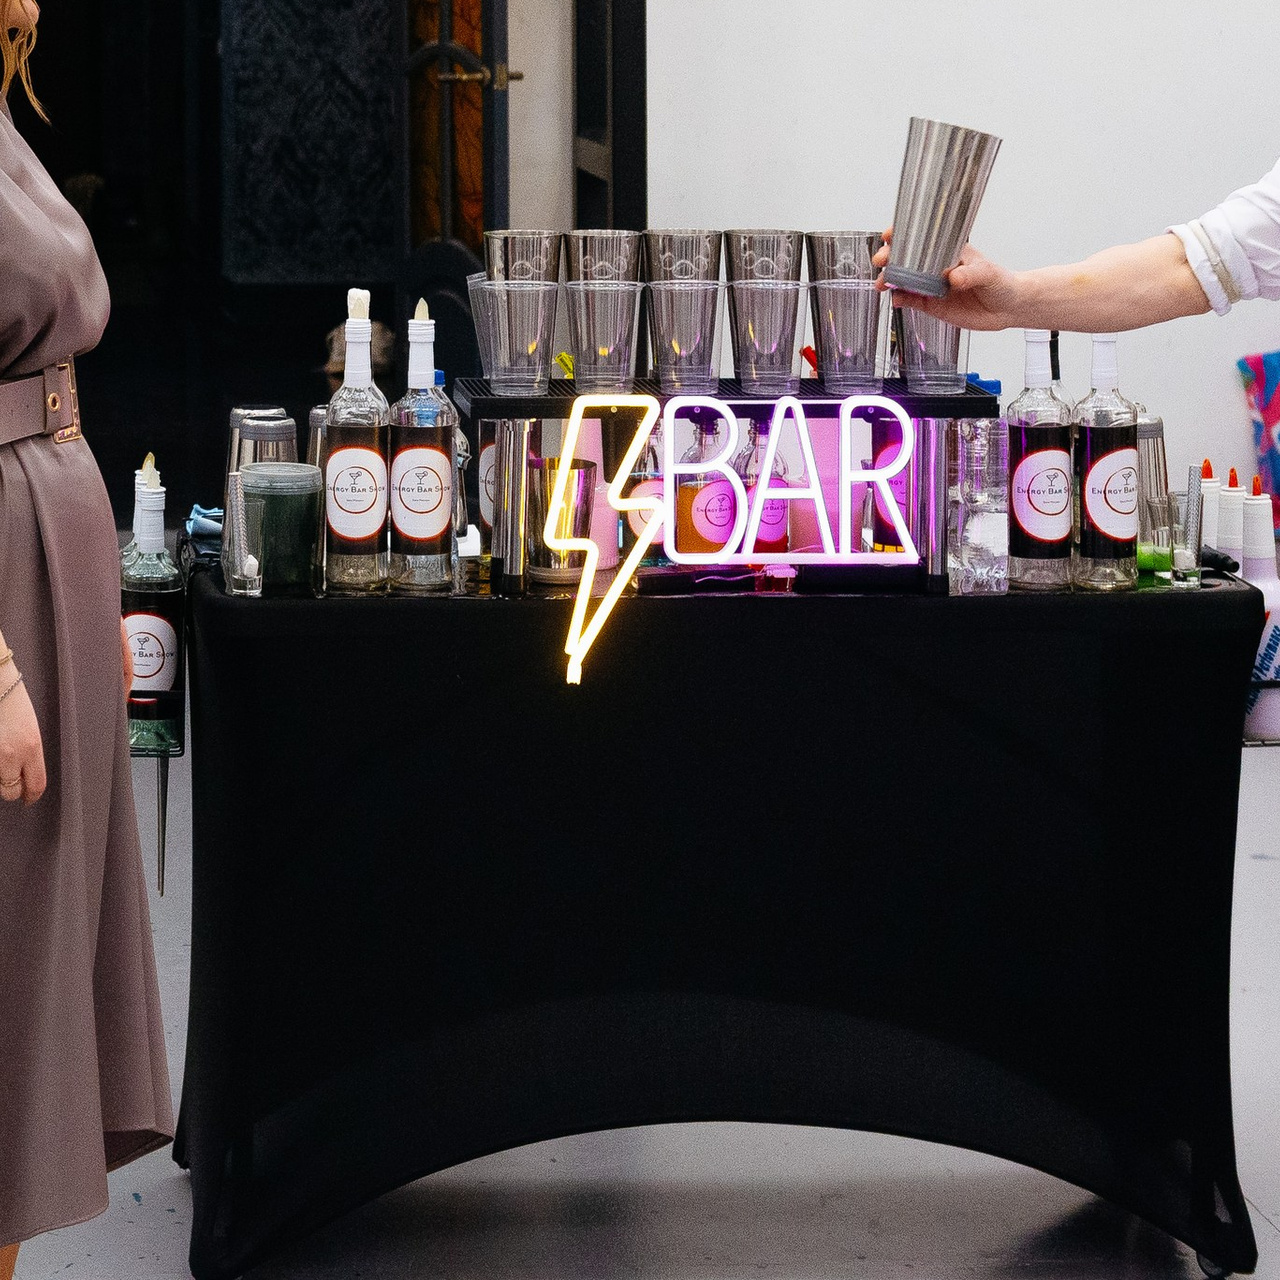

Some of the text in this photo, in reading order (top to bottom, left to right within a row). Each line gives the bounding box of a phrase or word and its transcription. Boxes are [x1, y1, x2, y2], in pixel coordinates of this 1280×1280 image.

[663, 395, 919, 564] BAR
[327, 483, 349, 493] ENRGY
[392, 483, 415, 493] ENRGY
[1016, 486, 1046, 495] ENRGY
[1091, 487, 1122, 495] ENRGY
